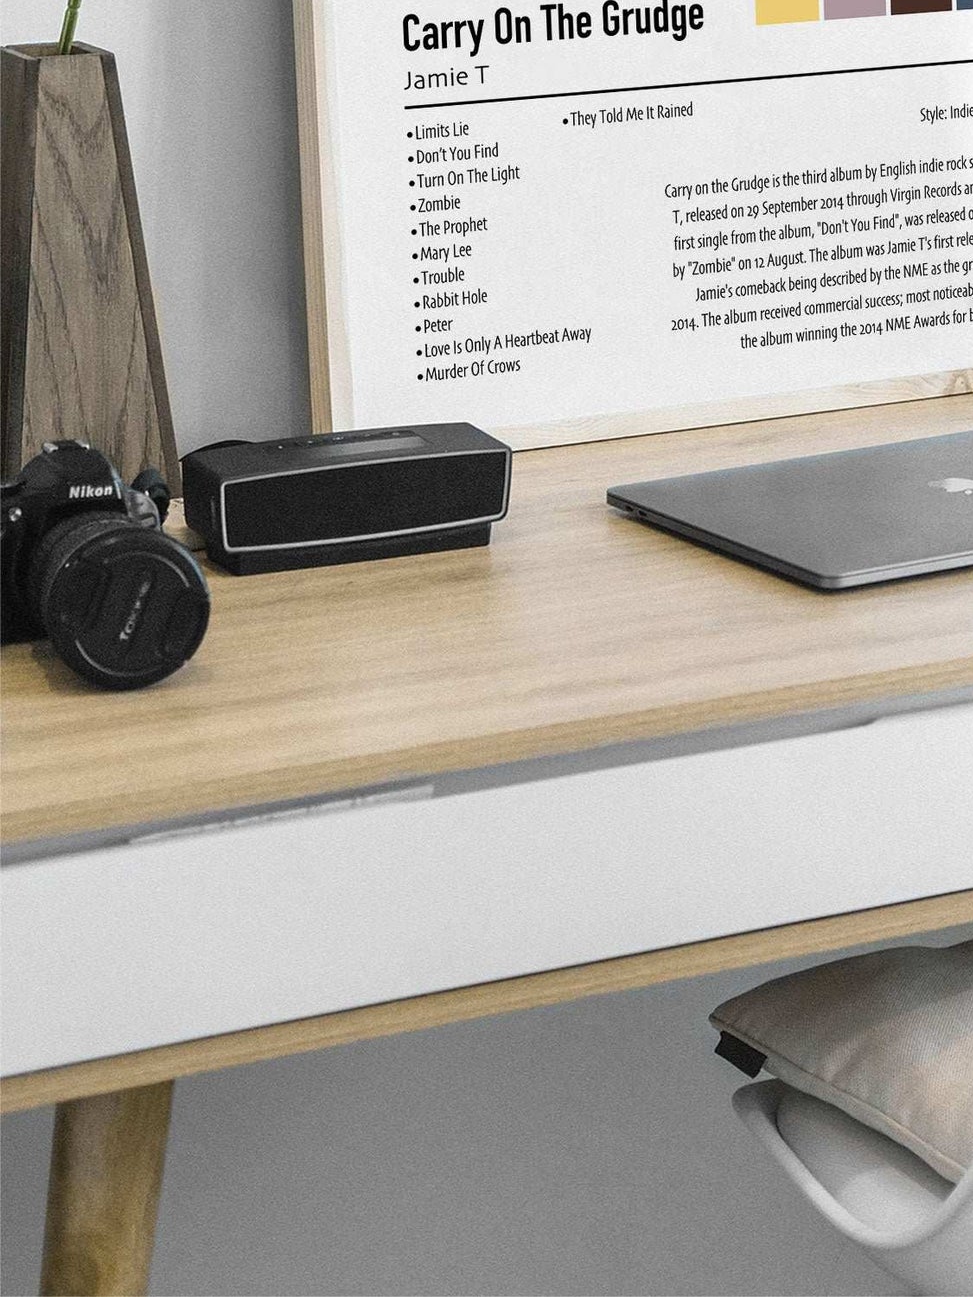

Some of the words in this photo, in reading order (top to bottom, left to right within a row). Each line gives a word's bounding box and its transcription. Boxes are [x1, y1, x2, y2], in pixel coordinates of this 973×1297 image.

[402, 13, 485, 57] Carry
[494, 7, 531, 45] On
[540, 3, 592, 41] The
[404, 67, 468, 90] Jamie
[474, 65, 490, 84] T
[570, 110, 597, 129] They
[599, 107, 623, 123] Told
[626, 107, 644, 121] Me
[646, 106, 655, 120] It
[657, 101, 693, 119] Rained
[920, 106, 947, 125] Style:
[415, 123, 450, 140] Limits
[453, 121, 469, 137] Lie
[449, 146, 471, 161] You
[474, 142, 499, 159] Find
[416, 174, 444, 188] Turn
[447, 170, 464, 186] On
[467, 168, 488, 183] The
[491, 165, 520, 185] Light
[664, 184, 693, 200] Carry
[695, 183, 708, 196] on
[711, 178, 729, 194] the
[731, 175, 770, 194] Grudge
[772, 174, 780, 188] is
[782, 172, 800, 187] the
[802, 168, 827, 185] third
[830, 167, 862, 182] album
[865, 164, 877, 182] by
[880, 160, 916, 180] English
[919, 158, 944, 173] indie
[946, 155, 967, 171] rock
[418, 195, 461, 213] Zombie
[672, 210, 683, 226] T,
[686, 204, 728, 223] released
[731, 207, 744, 218] on
[747, 205, 759, 219] 29
[762, 196, 818, 218] September
[820, 197, 844, 210] 2014
[846, 189, 888, 208] through
[890, 186, 921, 205] Virgin
[924, 181, 962, 199] Records
[419, 221, 440, 237] The
[444, 217, 488, 237] Prophet
[674, 235, 695, 250] first
[697, 231, 728, 251] single
[731, 230, 756, 244] from
[759, 227, 776, 242] the
[779, 224, 815, 240] album,
[817, 219, 849, 235] "Don't
[850, 218, 870, 232] You
[873, 213, 902, 230] Find",
[904, 214, 924, 227] was
[926, 206, 966, 224] released
[420, 246, 450, 263] Mary
[453, 244, 472, 258] Lee
[673, 263, 685, 281] by
[688, 256, 735, 275] "Zombie"
[738, 258, 752, 270] on
[754, 257, 765, 268] 12
[767, 251, 807, 270] August.
[809, 247, 828, 262] The
[831, 245, 863, 261] album
[866, 244, 885, 256] was
[887, 239, 916, 255] Jamie
[918, 236, 932, 251] T's
[934, 234, 954, 249] first
[421, 266, 465, 285] Trouble
[696, 284, 733, 302] Jamie's
[735, 277, 786, 297] comeback
[788, 276, 817, 293] being
[820, 268, 867, 287] described
[870, 268, 882, 285] by
[884, 265, 901, 280] the
[903, 262, 928, 278] NME
[931, 264, 941, 275] as
[943, 259, 960, 274] the
[423, 292, 459, 309] Rabbit
[462, 288, 487, 305] Hole
[671, 318, 699, 331] 2014.
[701, 312, 721, 327] The
[724, 309, 757, 325] album
[760, 302, 801, 320] received
[804, 295, 862, 315] commercial
[865, 294, 903, 309] success;
[906, 289, 931, 304] most
[424, 319, 453, 334] Peter
[740, 334, 758, 349] the
[760, 331, 793, 347] album
[795, 326, 837, 342] winning
[840, 322, 857, 337] the
[860, 322, 883, 335] 2014
[886, 316, 911, 332] NME
[913, 311, 950, 329] Awards
[952, 309, 967, 324] for
[425, 344, 450, 358] Love
[453, 340, 462, 354] Is
[465, 336, 491, 355] Only
[494, 335, 502, 350] A
[505, 330, 560, 348] Heartbeat
[562, 328, 591, 343] Away
[426, 363, 469, 382] Murder
[471, 360, 484, 376] Of
[487, 360, 521, 374] Crows
[69, 485, 113, 499] Nikon
